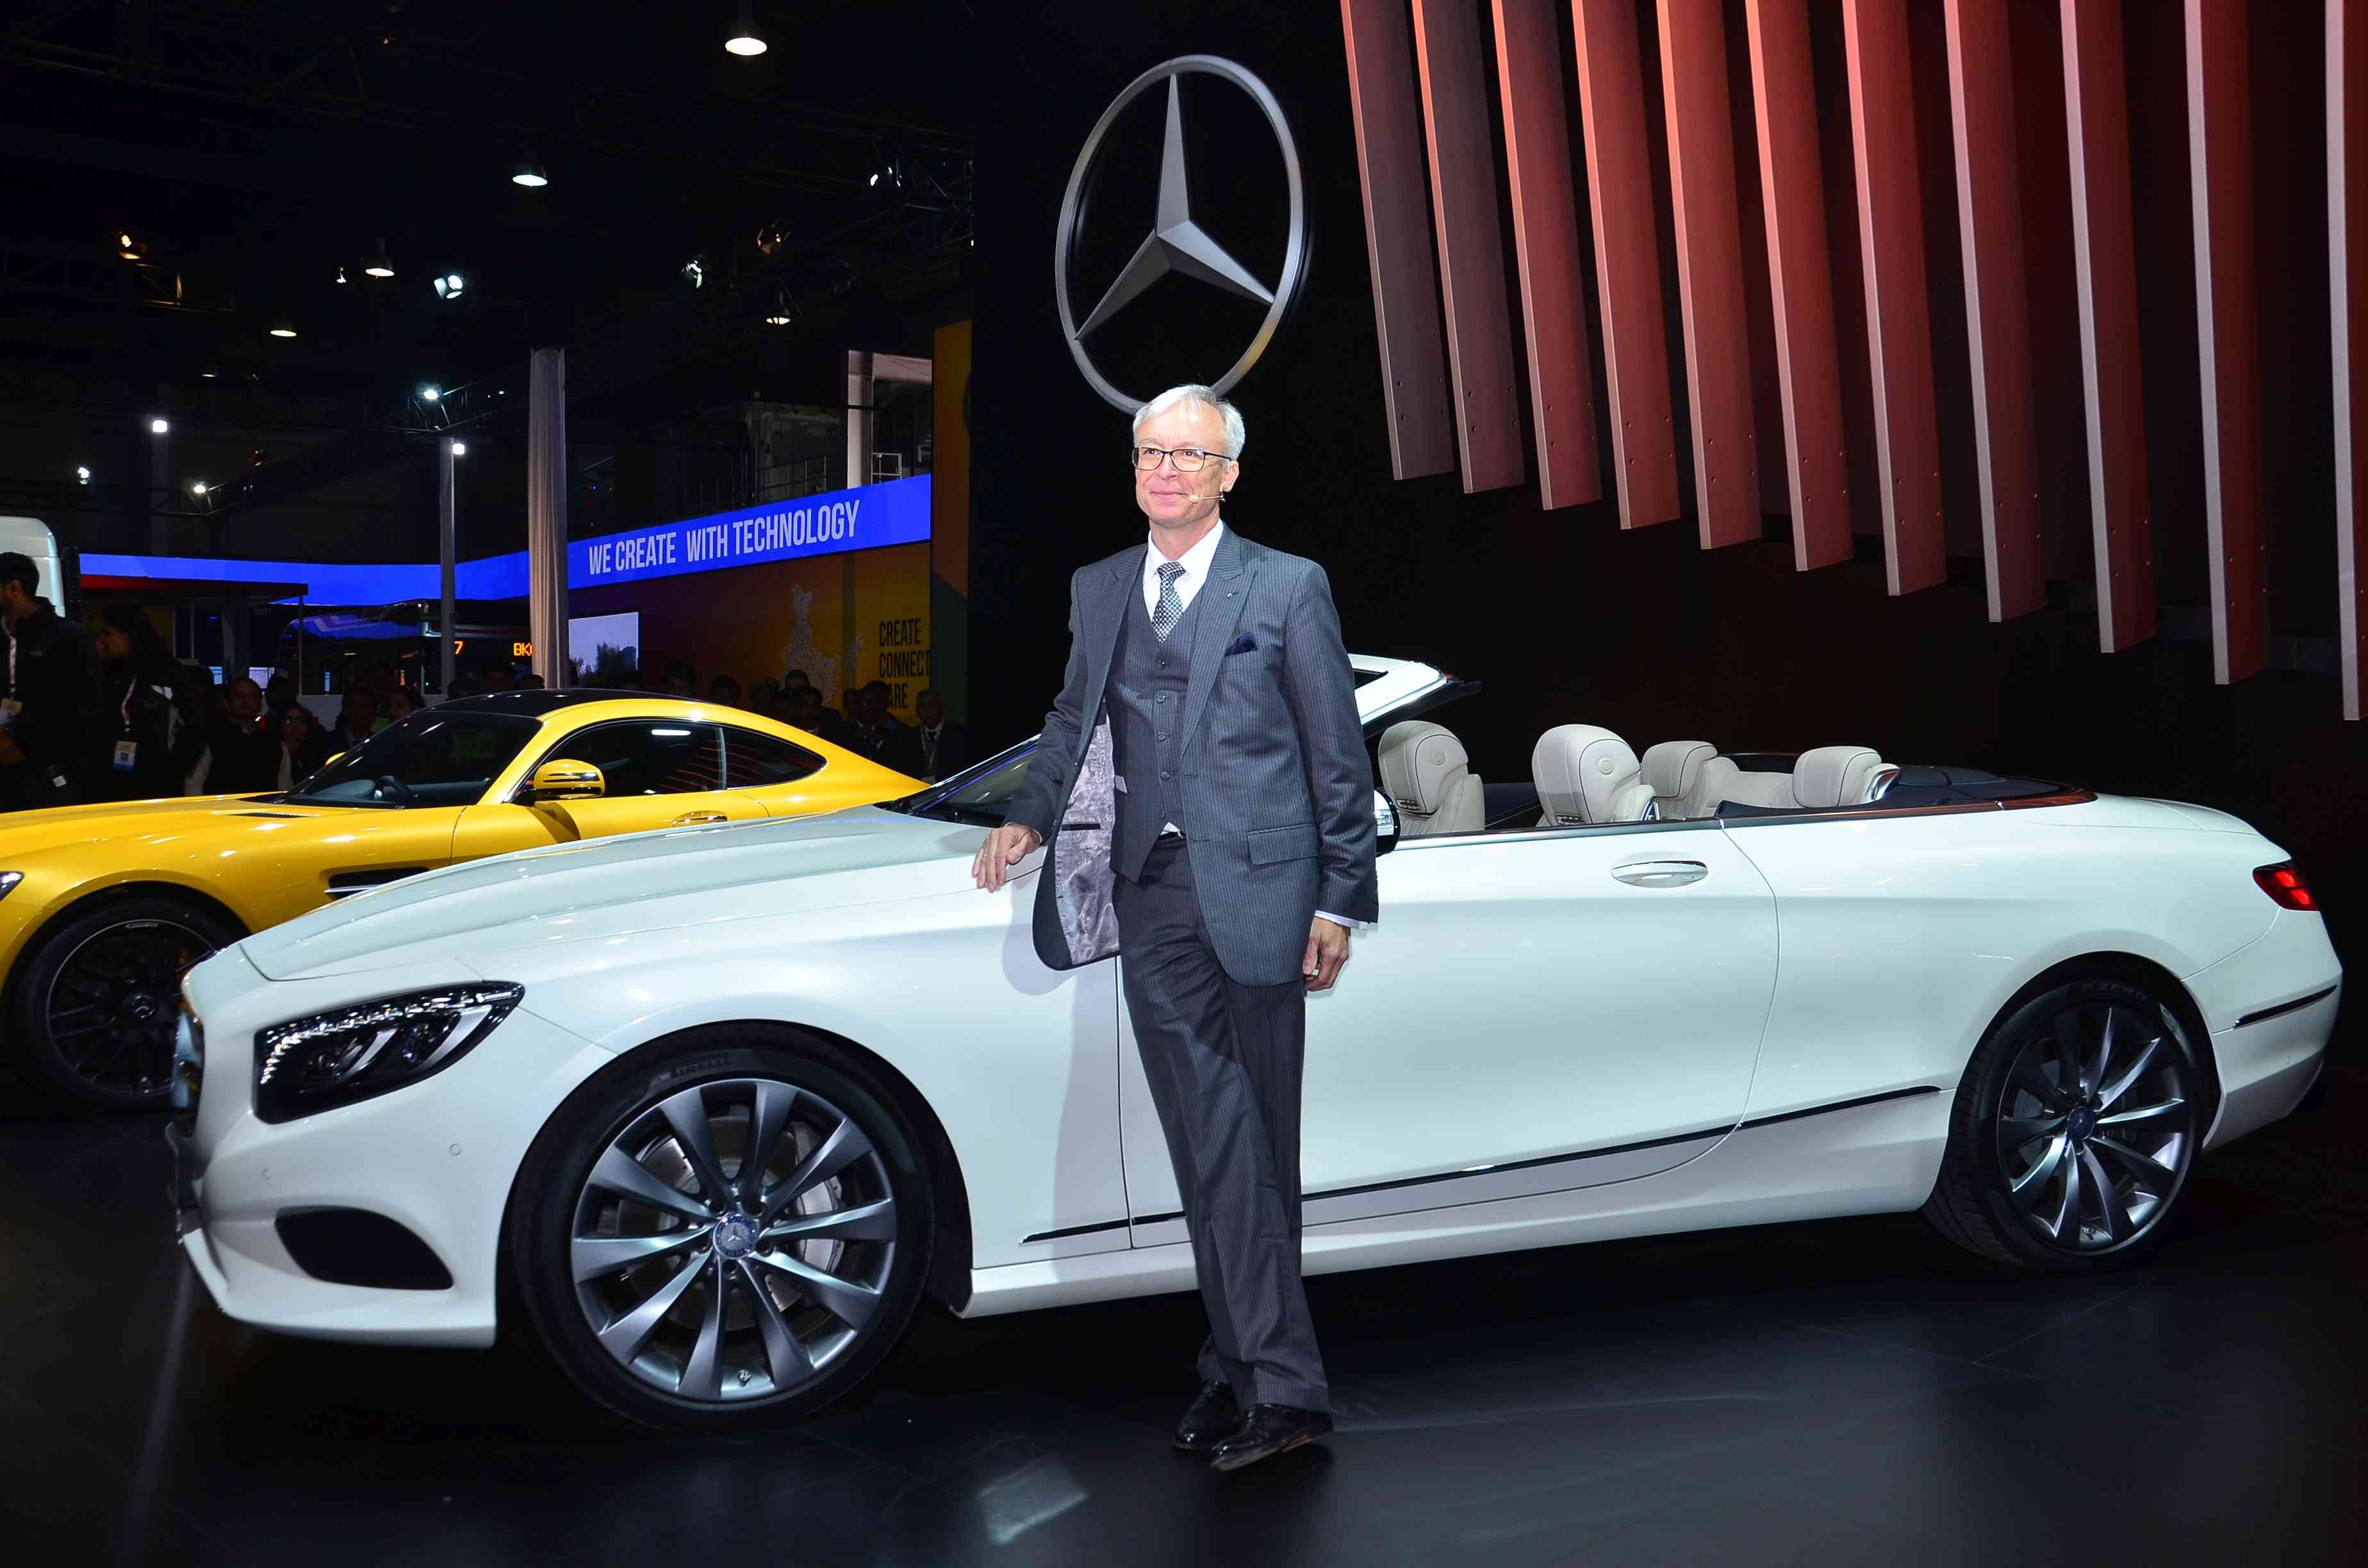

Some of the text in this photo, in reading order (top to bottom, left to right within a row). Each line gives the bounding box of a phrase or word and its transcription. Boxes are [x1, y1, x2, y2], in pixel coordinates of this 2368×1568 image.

[589, 500, 860, 575] WE CREATE WITH TECHNOLOGY
[879, 618, 921, 646] CREATE
[879, 649, 931, 678] CONNECT
[886, 683, 908, 709] ARE
